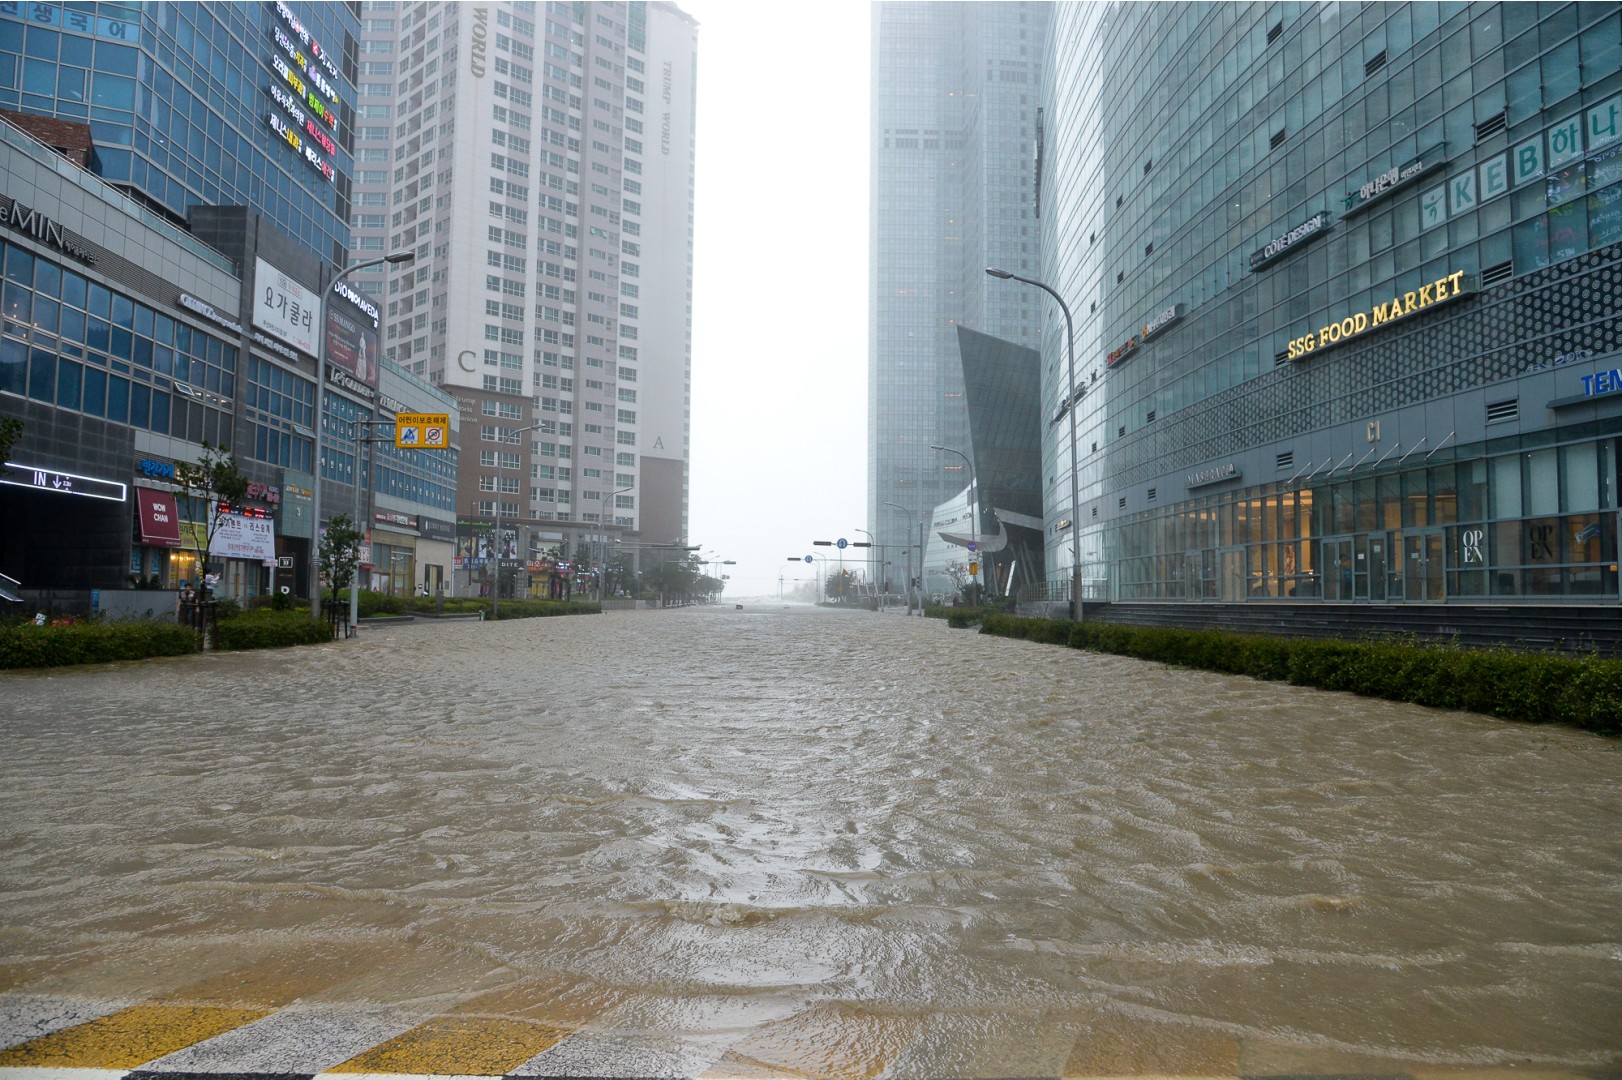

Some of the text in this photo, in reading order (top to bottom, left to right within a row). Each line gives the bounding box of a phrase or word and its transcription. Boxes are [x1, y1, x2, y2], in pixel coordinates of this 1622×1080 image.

[472, 8, 488, 78] WORLD
[661, 60, 672, 155] TRUMP WORLD
[1359, 166, 1399, 199] 하나은행
[1287, 215, 1321, 246] DESIGN
[264, 286, 312, 333] 요가쿨라
[1287, 270, 1464, 359] SSG FOOD MARKET
[458, 350, 477, 373] C
[399, 416, 446, 424] 어린이보호해제
[1367, 420, 1380, 442] C1
[653, 435, 665, 450] A
[33, 471, 46, 487] IN
[153, 503, 166, 513] WOW
[153, 514, 169, 523] CHAN
